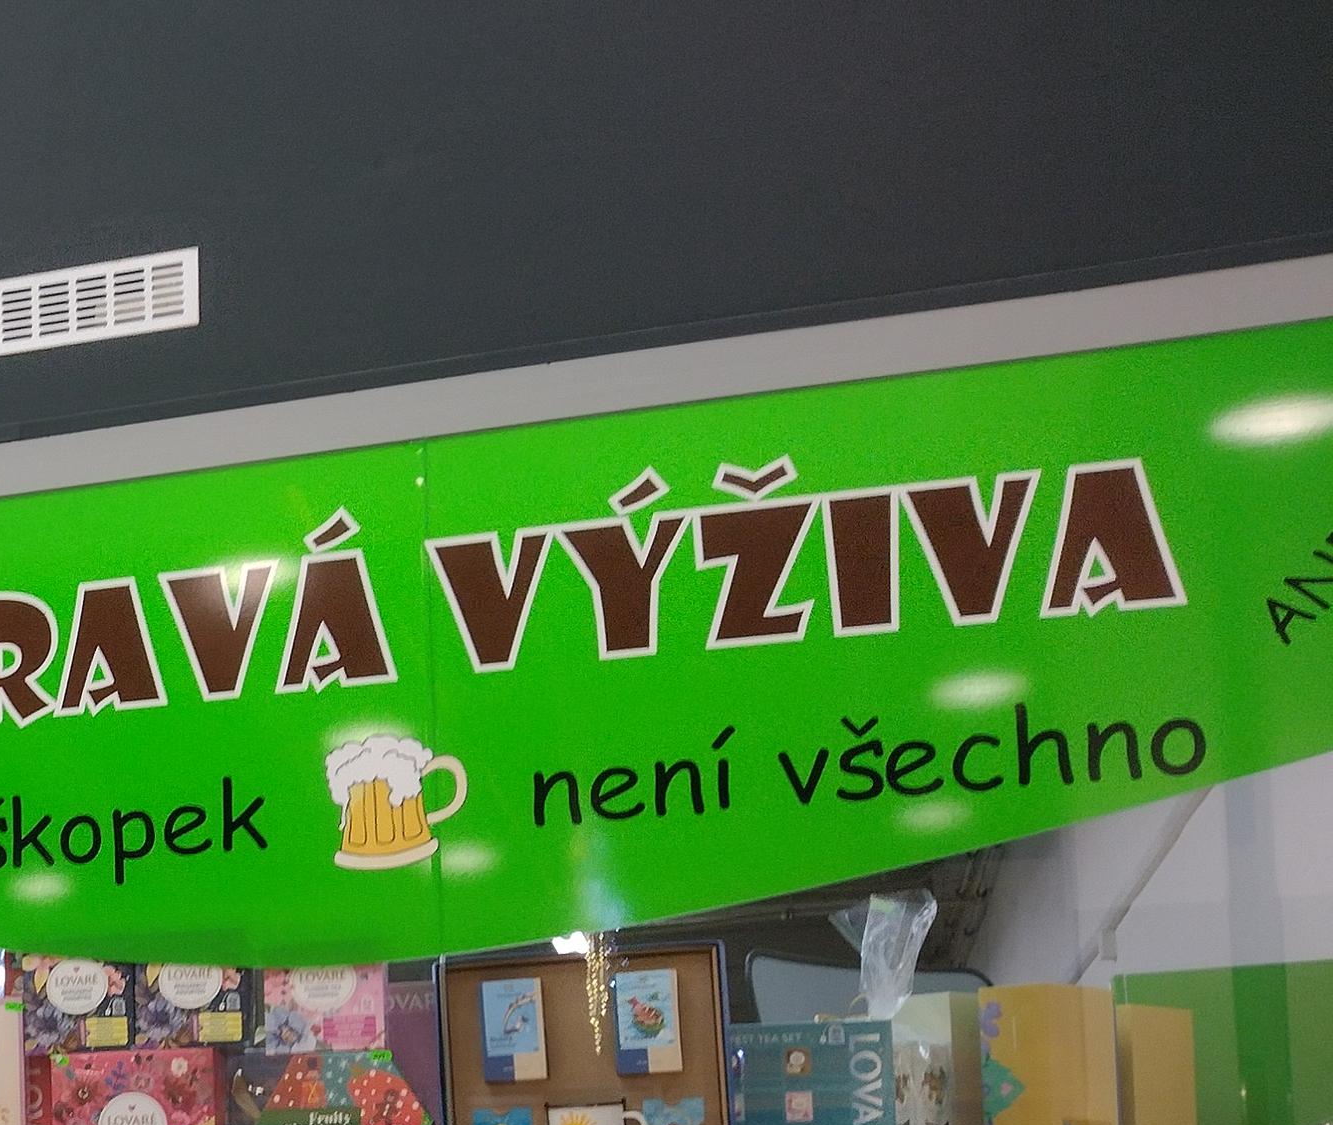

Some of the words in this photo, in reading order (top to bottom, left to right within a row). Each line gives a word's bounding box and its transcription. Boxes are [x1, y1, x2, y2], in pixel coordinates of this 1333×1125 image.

[425, 455, 1187, 673] VÝŽIVA
[1266, 532, 1333, 646] AN
[534, 725, 736, 826] není
[779, 703, 1206, 812] všechno
